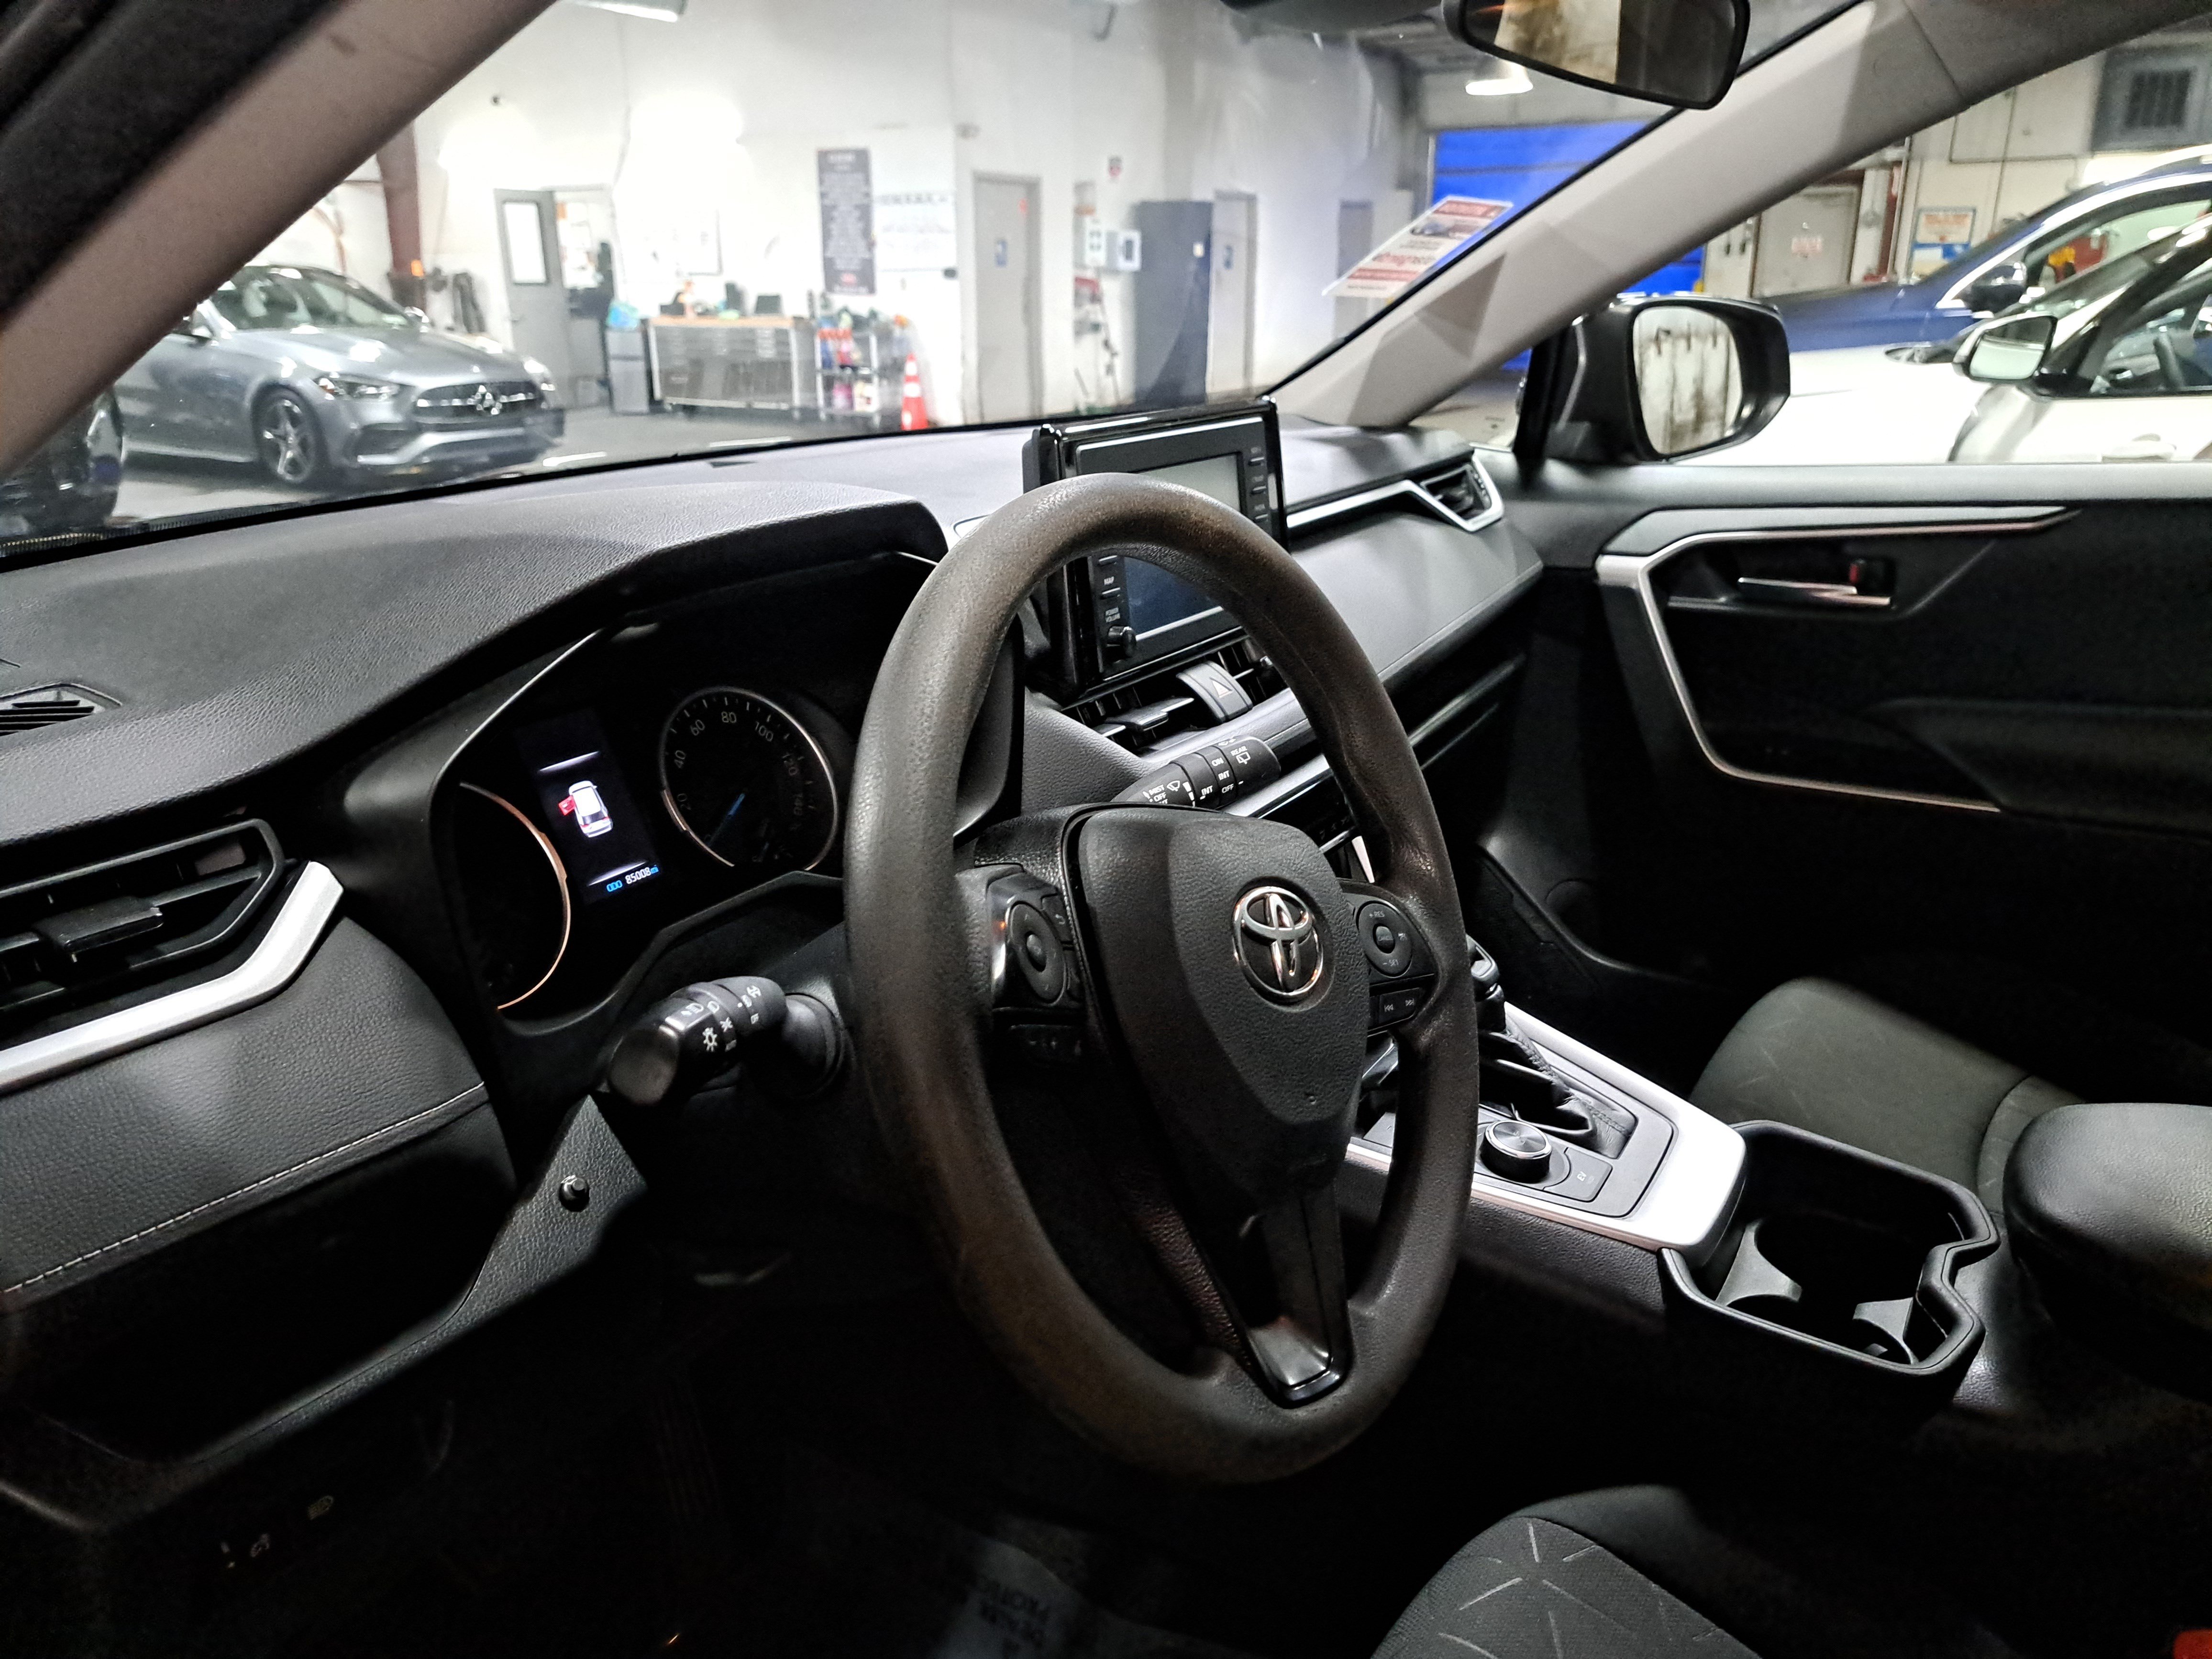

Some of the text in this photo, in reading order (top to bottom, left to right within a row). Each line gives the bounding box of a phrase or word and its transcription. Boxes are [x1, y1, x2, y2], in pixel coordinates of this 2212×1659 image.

[721, 710, 737, 724] 80
[690, 719, 705, 736] 60
[754, 721, 774, 742] 100
[1230, 746, 1247, 756] REAR
[674, 750, 686, 769] 40
[1212, 757, 1224, 766] ON
[1218, 770, 1229, 780] INT
[1149, 784, 1164, 796] MIST
[1201, 785, 1213, 795] INT
[1221, 783, 1234, 793] OFF
[677, 793, 692, 810] 20
[1153, 792, 1166, 802] OFF
[607, 880, 623, 892] ODO
[625, 867, 652, 884] 85008
